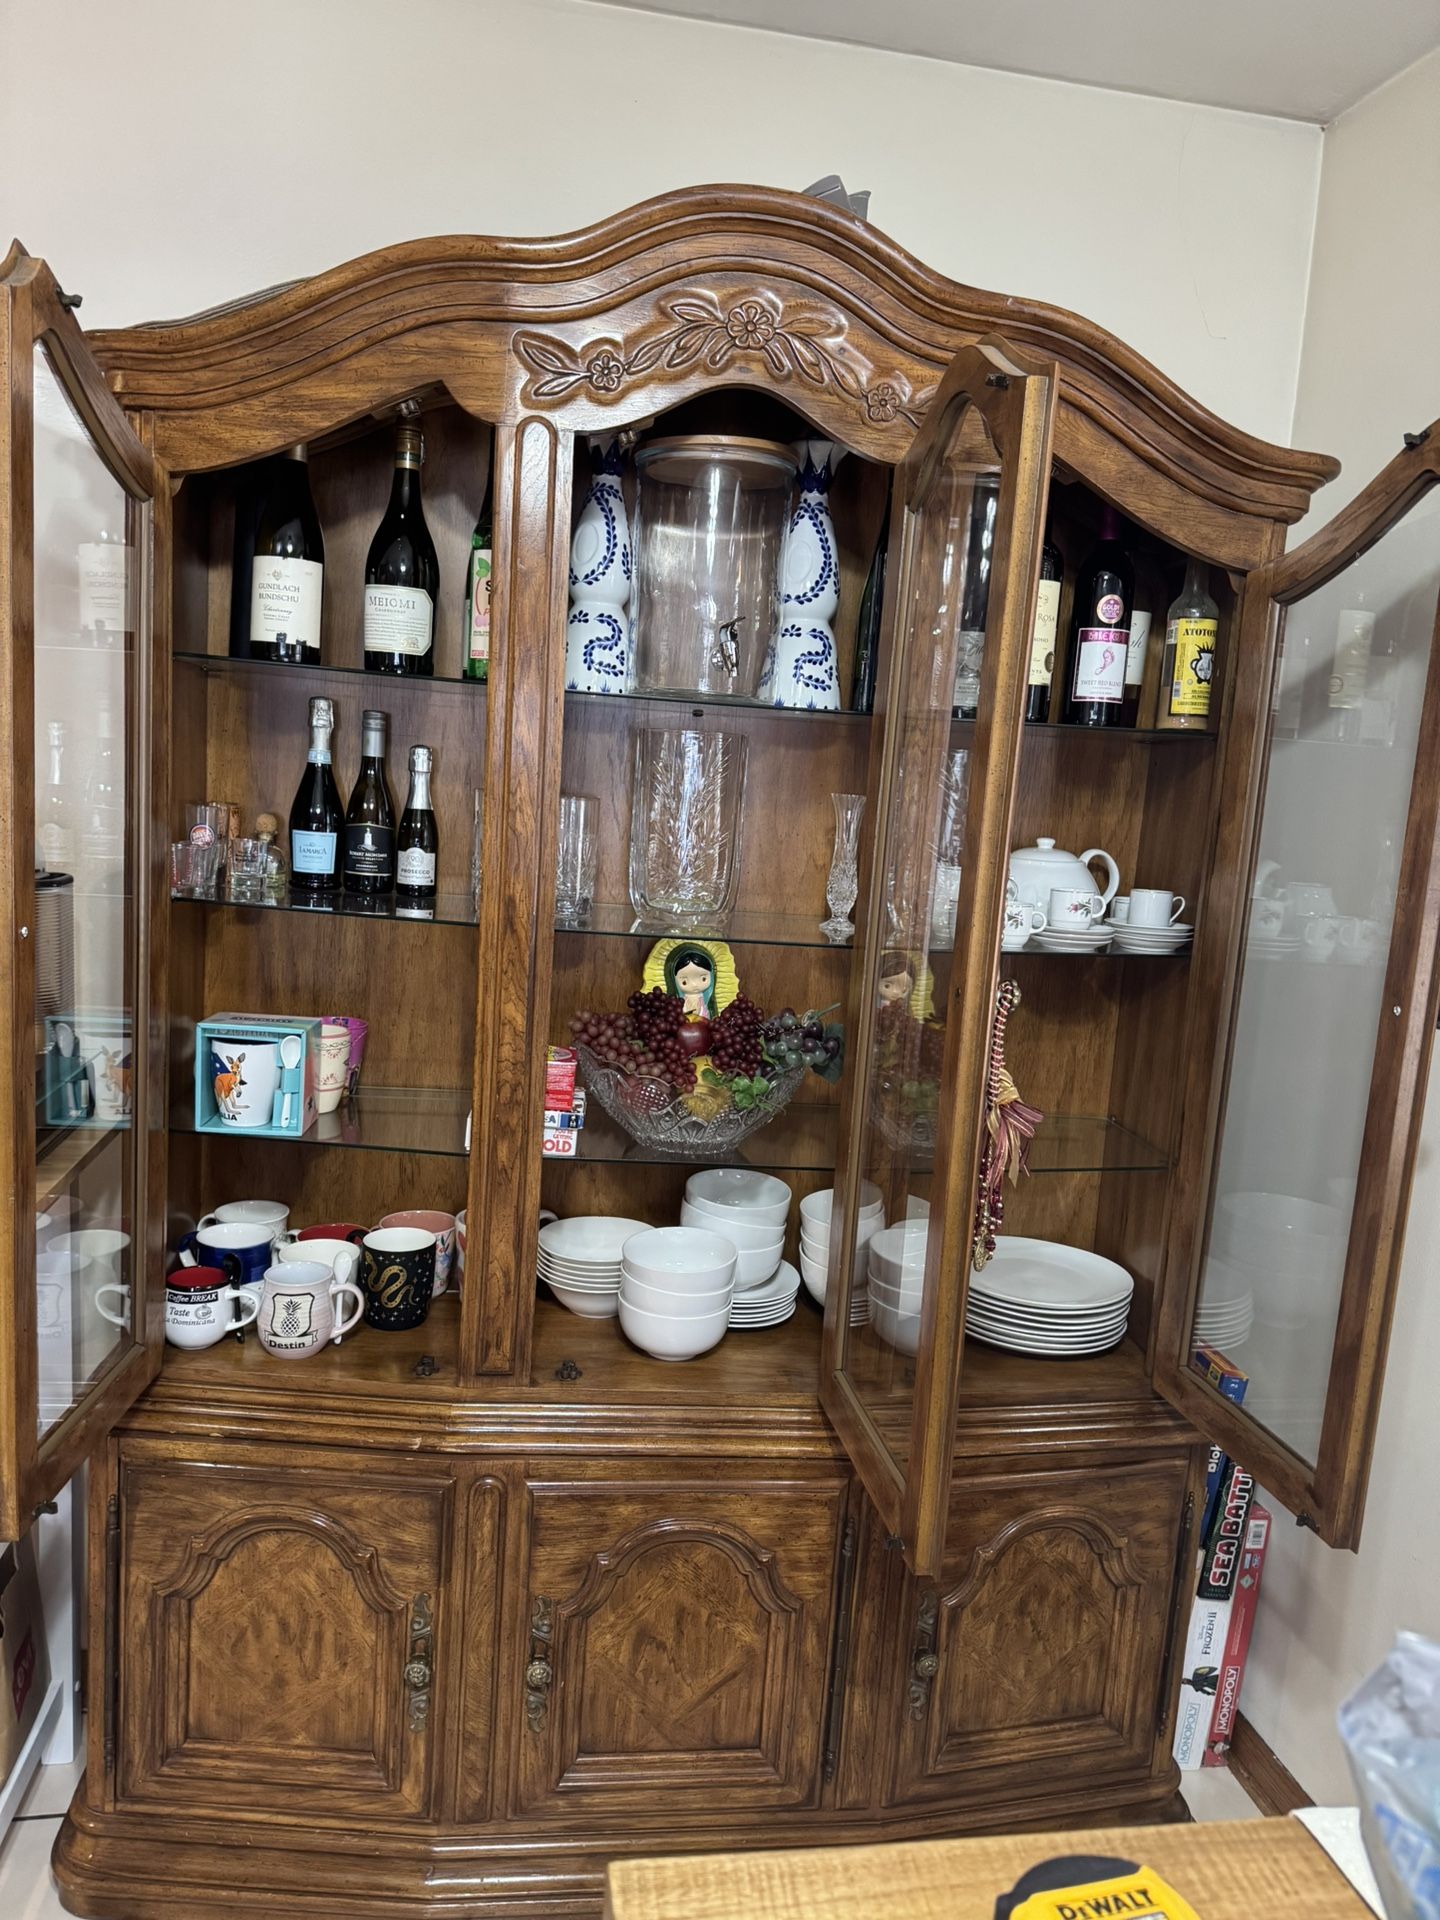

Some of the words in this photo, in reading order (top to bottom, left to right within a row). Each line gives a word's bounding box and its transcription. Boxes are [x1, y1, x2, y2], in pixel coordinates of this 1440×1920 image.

[258, 583, 300, 593] GUNDLACH
[258, 592, 300, 603] BUNDSCHU
[369, 596, 416, 609] MEIOMI
[543, 1139, 572, 1153] OLD
[169, 1293, 190, 1303] Coffee
[190, 1293, 217, 1303] BREAK
[169, 1306, 190, 1317] Taste
[269, 1339, 306, 1350] Destin
[1209, 1538, 1238, 1587] SEA
[1202, 1619, 1215, 1655] FROZEN
[1218, 1667, 1238, 1731] MONOPOLY
[1180, 1707, 1200, 1763] MONOPOLY
